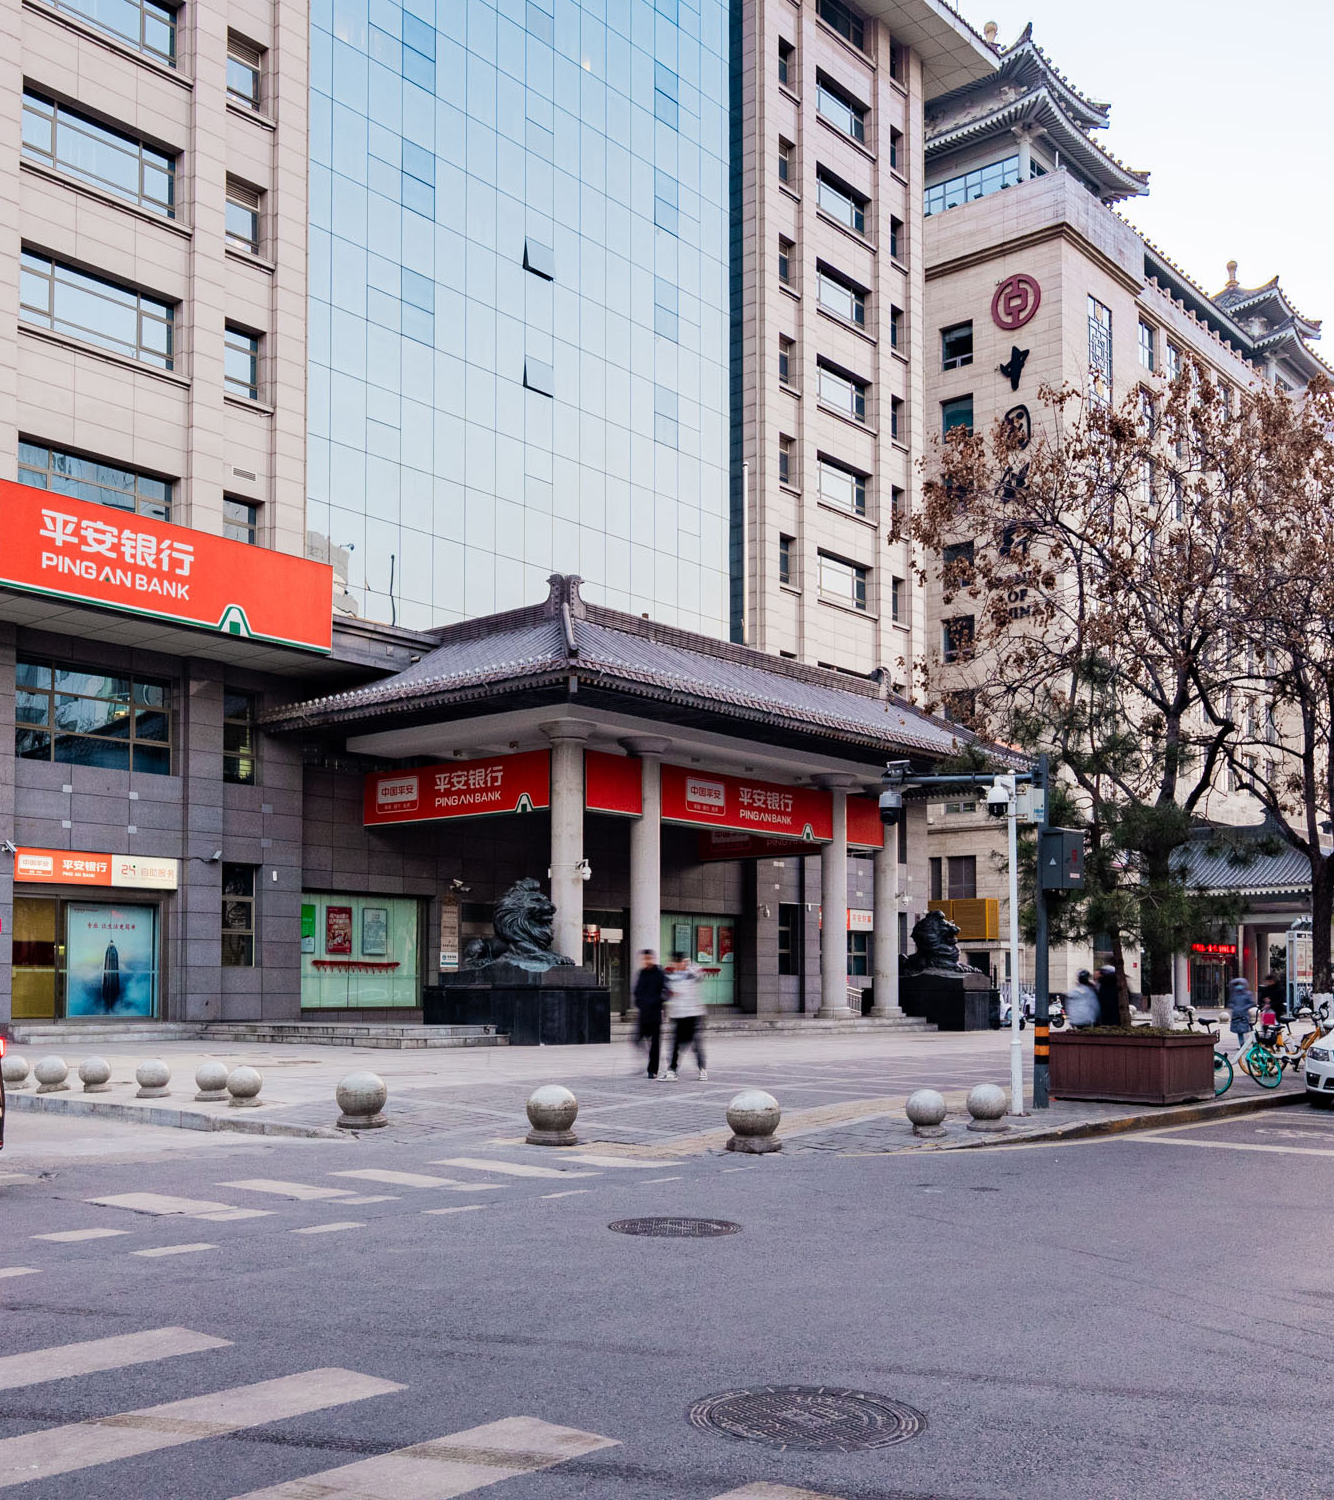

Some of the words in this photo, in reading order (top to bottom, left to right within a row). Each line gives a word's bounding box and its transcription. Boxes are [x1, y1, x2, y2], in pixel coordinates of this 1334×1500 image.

[39, 508, 195, 577] 平安银行
[135, 573, 190, 601] BANK
[1008, 589, 1028, 603] OF
[435, 766, 504, 793] 平安银行
[381, 785, 414, 797] 中国平安
[475, 791, 501, 803] BANK
[690, 786, 721, 800] 中国平安
[739, 787, 793, 812] 平安银行
[772, 814, 792, 825] BANK
[62, 860, 107, 873] 平安银行
[121, 864, 136, 876] 24
[141, 868, 175, 878] 自助服务
